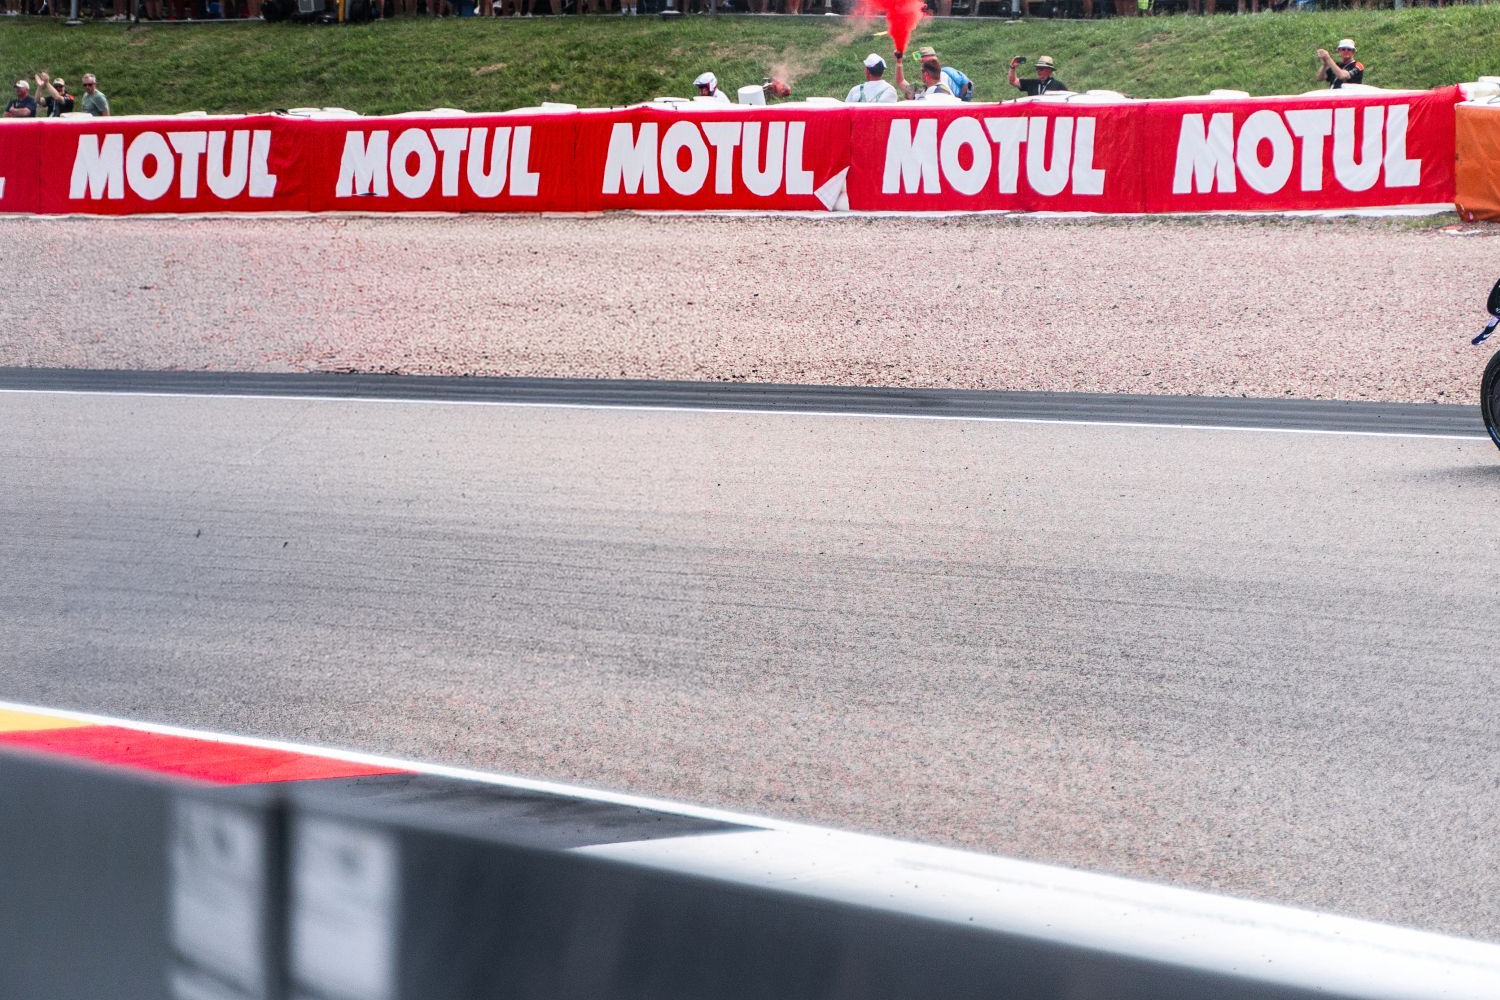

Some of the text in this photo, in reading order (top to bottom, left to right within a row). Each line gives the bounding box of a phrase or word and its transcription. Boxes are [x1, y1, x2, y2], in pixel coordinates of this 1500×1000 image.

[69, 130, 277, 200] MOTUL
[336, 126, 540, 198] MOTUL
[602, 121, 814, 196] MOTUL
[882, 116, 1106, 196] MOTUL
[1172, 104, 1422, 195] MOTUL
